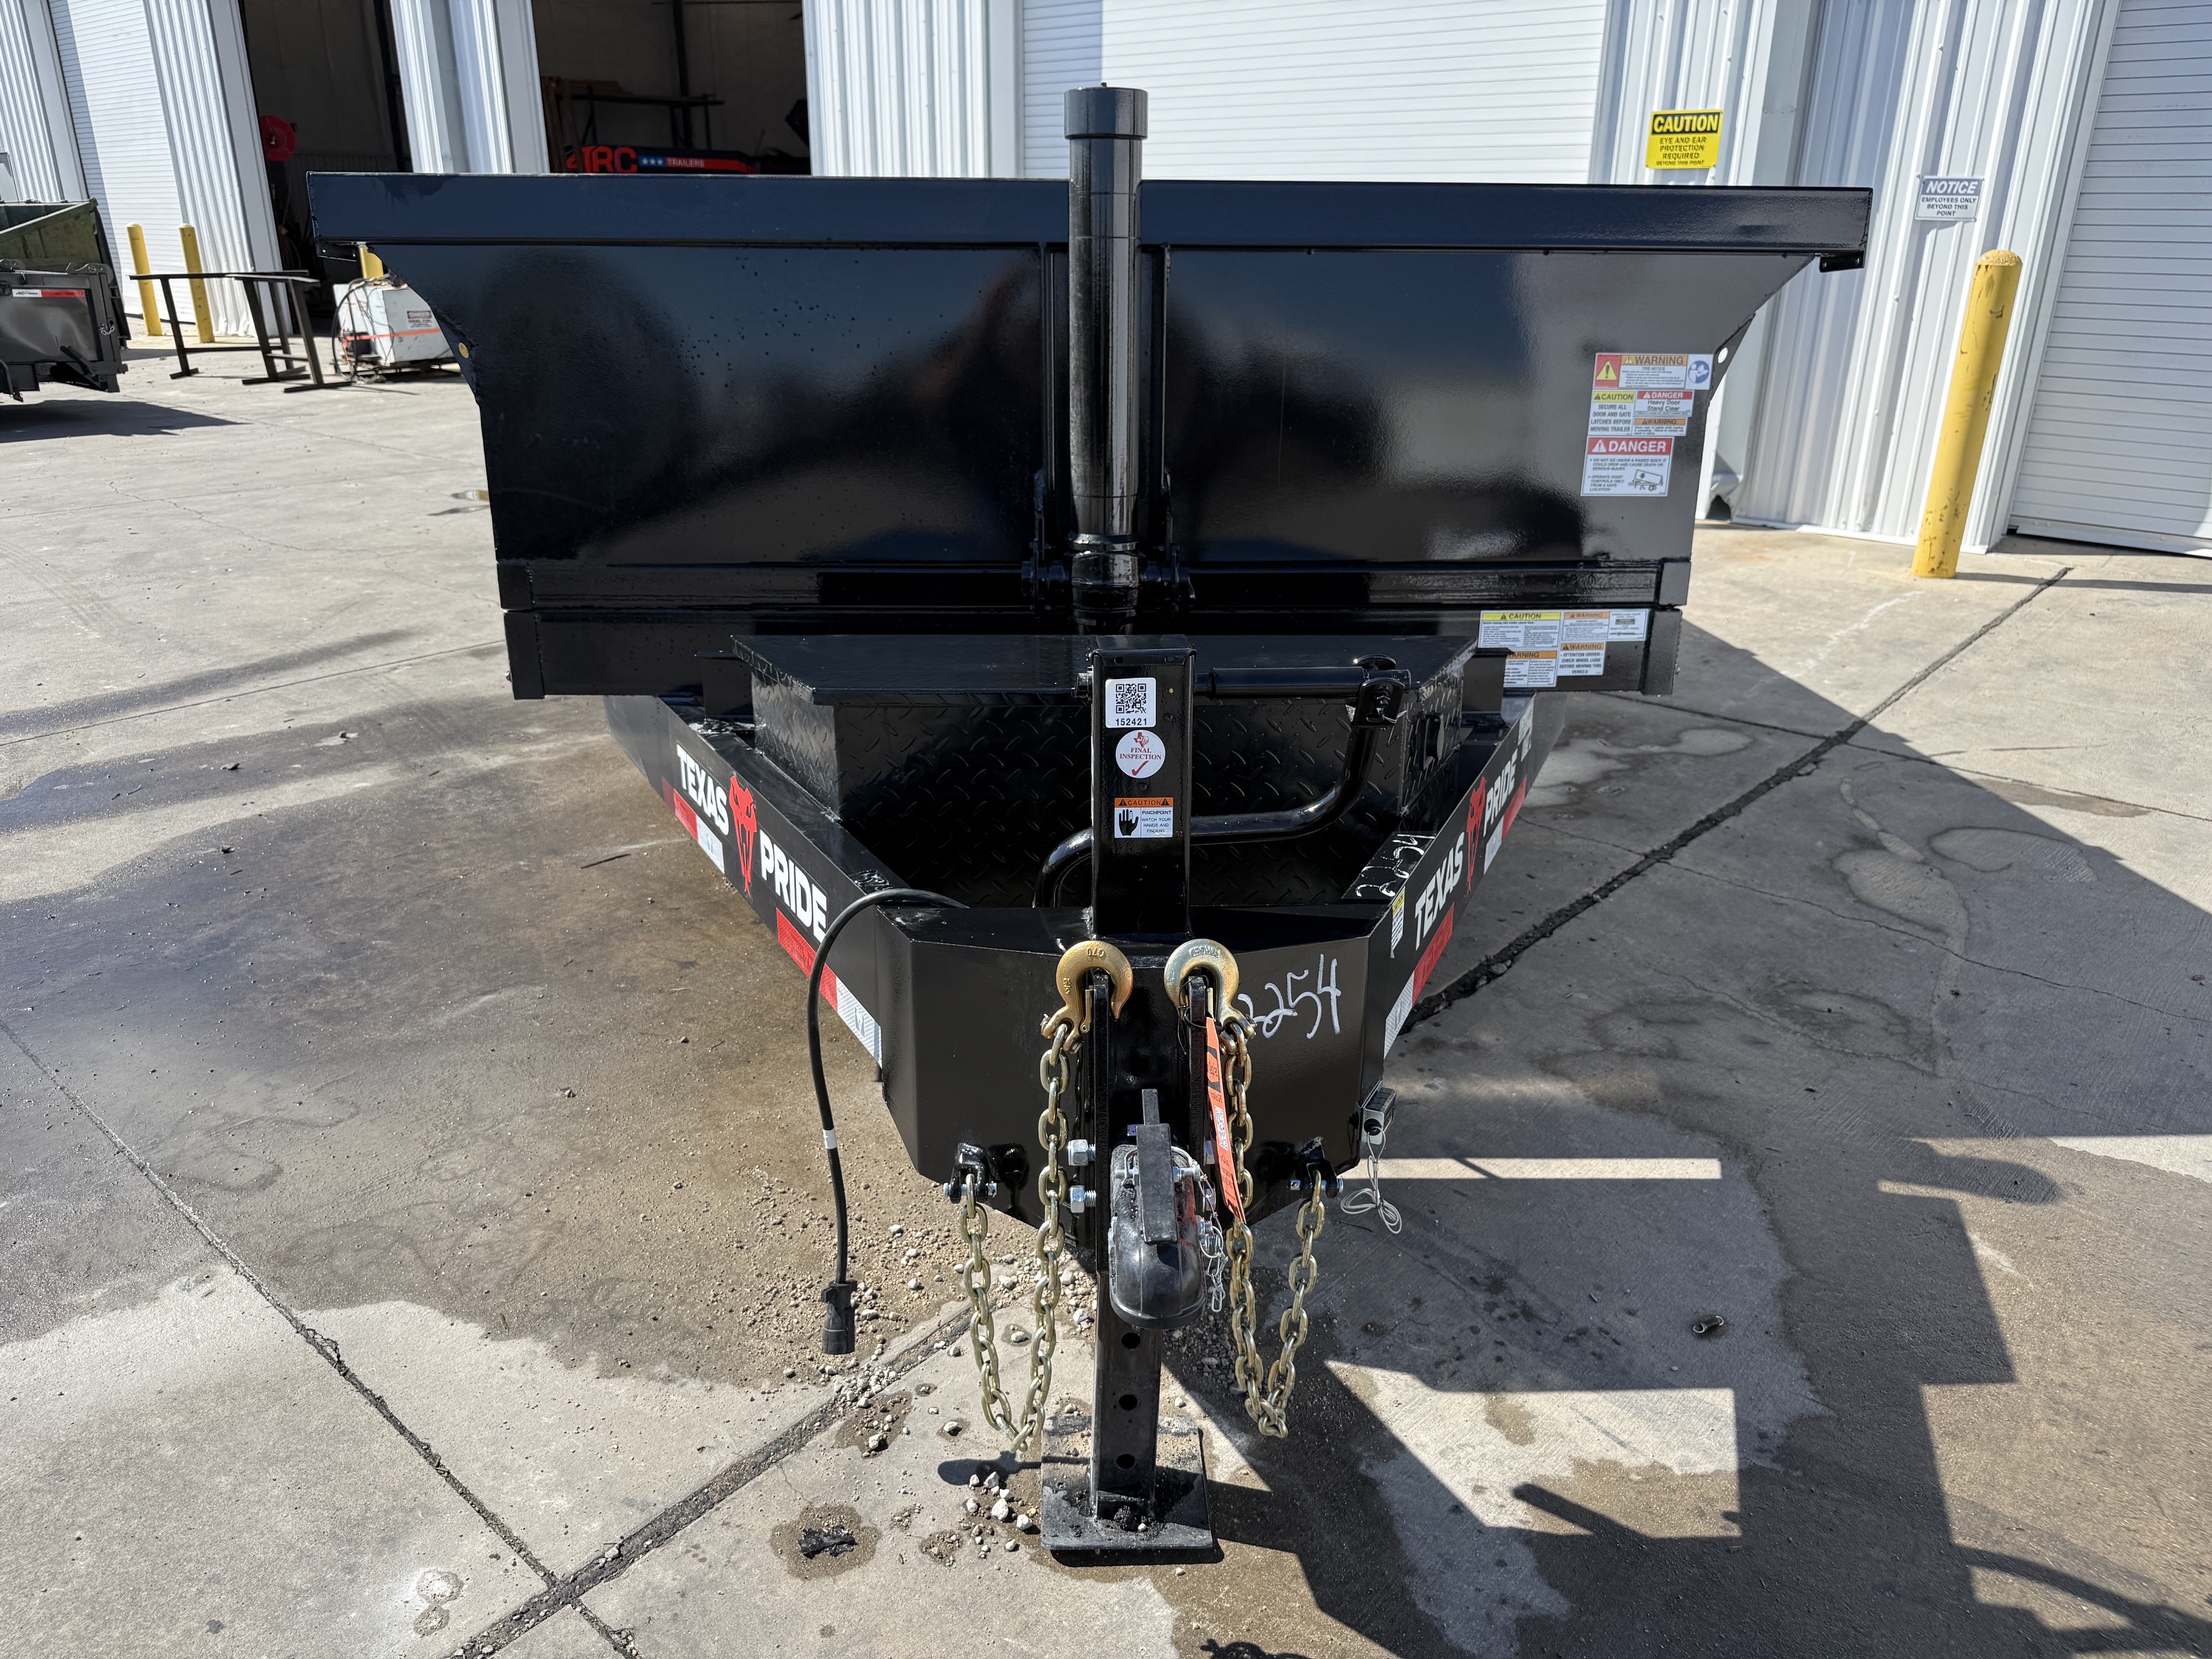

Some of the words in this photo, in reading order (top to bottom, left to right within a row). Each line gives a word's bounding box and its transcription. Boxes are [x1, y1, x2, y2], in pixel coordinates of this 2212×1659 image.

[1653, 115, 1719, 133] CAUTION
[667, 158, 705, 167] TRAILERS
[1925, 180, 1978, 194] NOTICE
[1635, 356, 1684, 365] WARNING
[1609, 441, 1667, 452] DANGER
[1115, 717, 1147, 726] 152421
[677, 743, 730, 836] TEXAS
[1482, 748, 1518, 837] PRIDE
[759, 829, 828, 943] PRIDE
[1414, 831, 1465, 950] TEXAS
[1087, 947, 1106, 957] G70
[1238, 953, 1341, 1039] 2254
